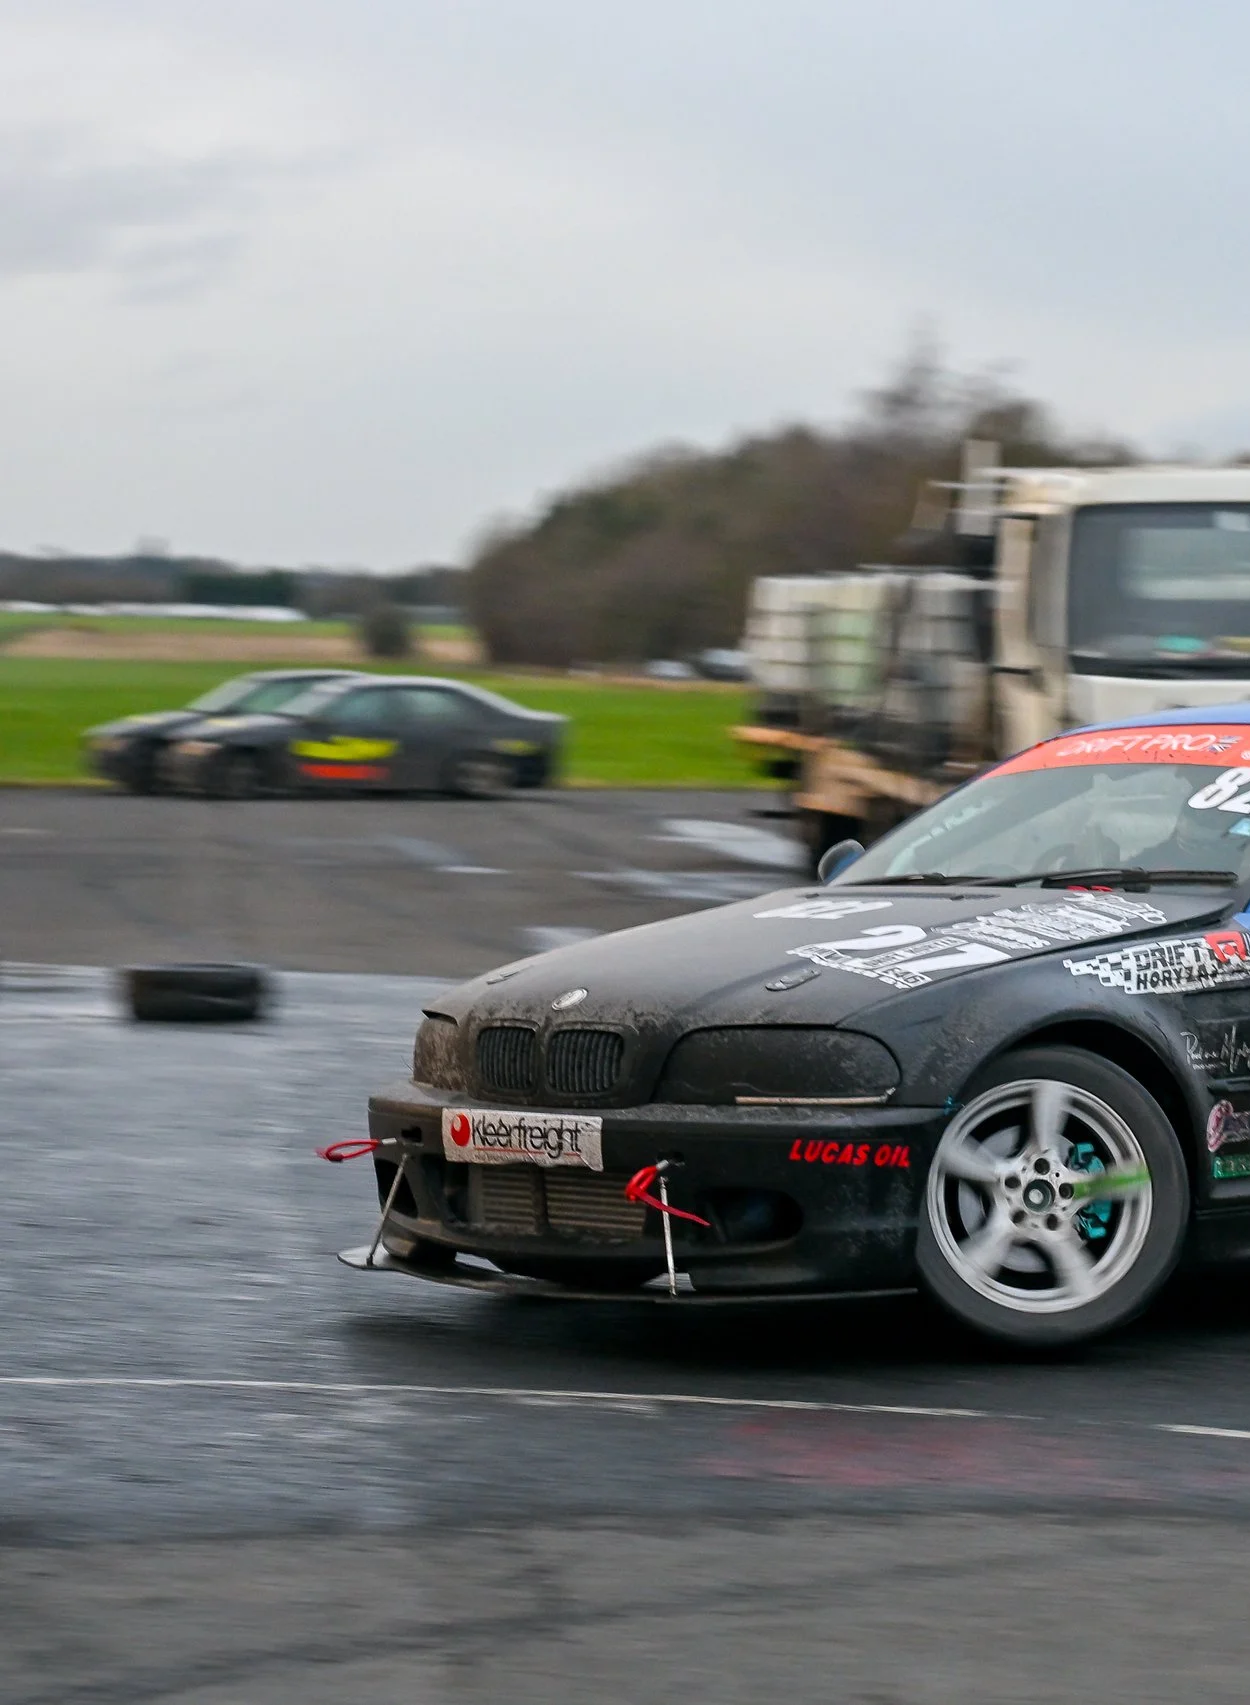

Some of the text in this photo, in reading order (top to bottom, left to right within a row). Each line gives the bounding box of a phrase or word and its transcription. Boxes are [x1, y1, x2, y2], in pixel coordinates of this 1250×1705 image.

[1140, 733, 1217, 751] PRO
[789, 1139, 910, 1168] LUCAS OIL
